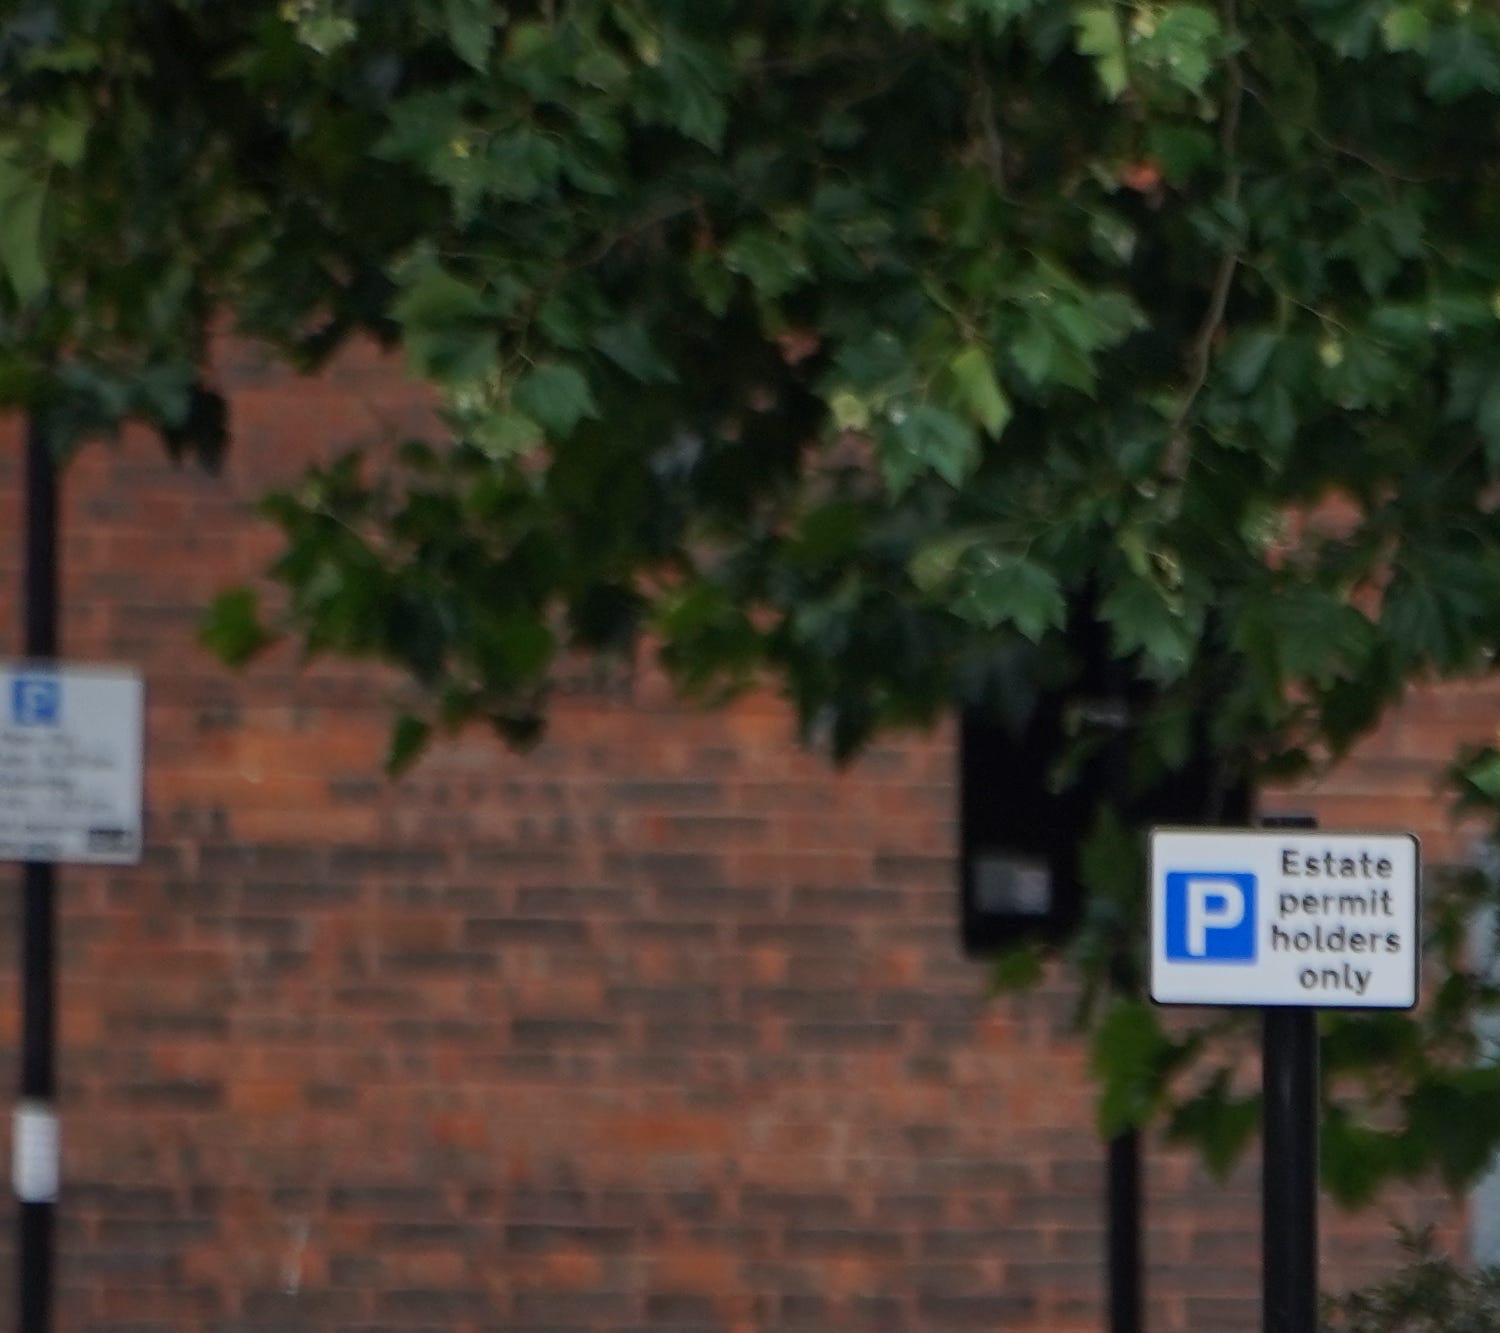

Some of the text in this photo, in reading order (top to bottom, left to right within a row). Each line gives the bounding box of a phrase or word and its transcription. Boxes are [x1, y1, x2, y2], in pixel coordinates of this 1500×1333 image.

[1281, 849, 1393, 879] Estate
[1187, 881, 1245, 957] P
[1279, 889, 1394, 919] permit
[1271, 924, 1402, 954] holders
[1299, 964, 1373, 996] only
